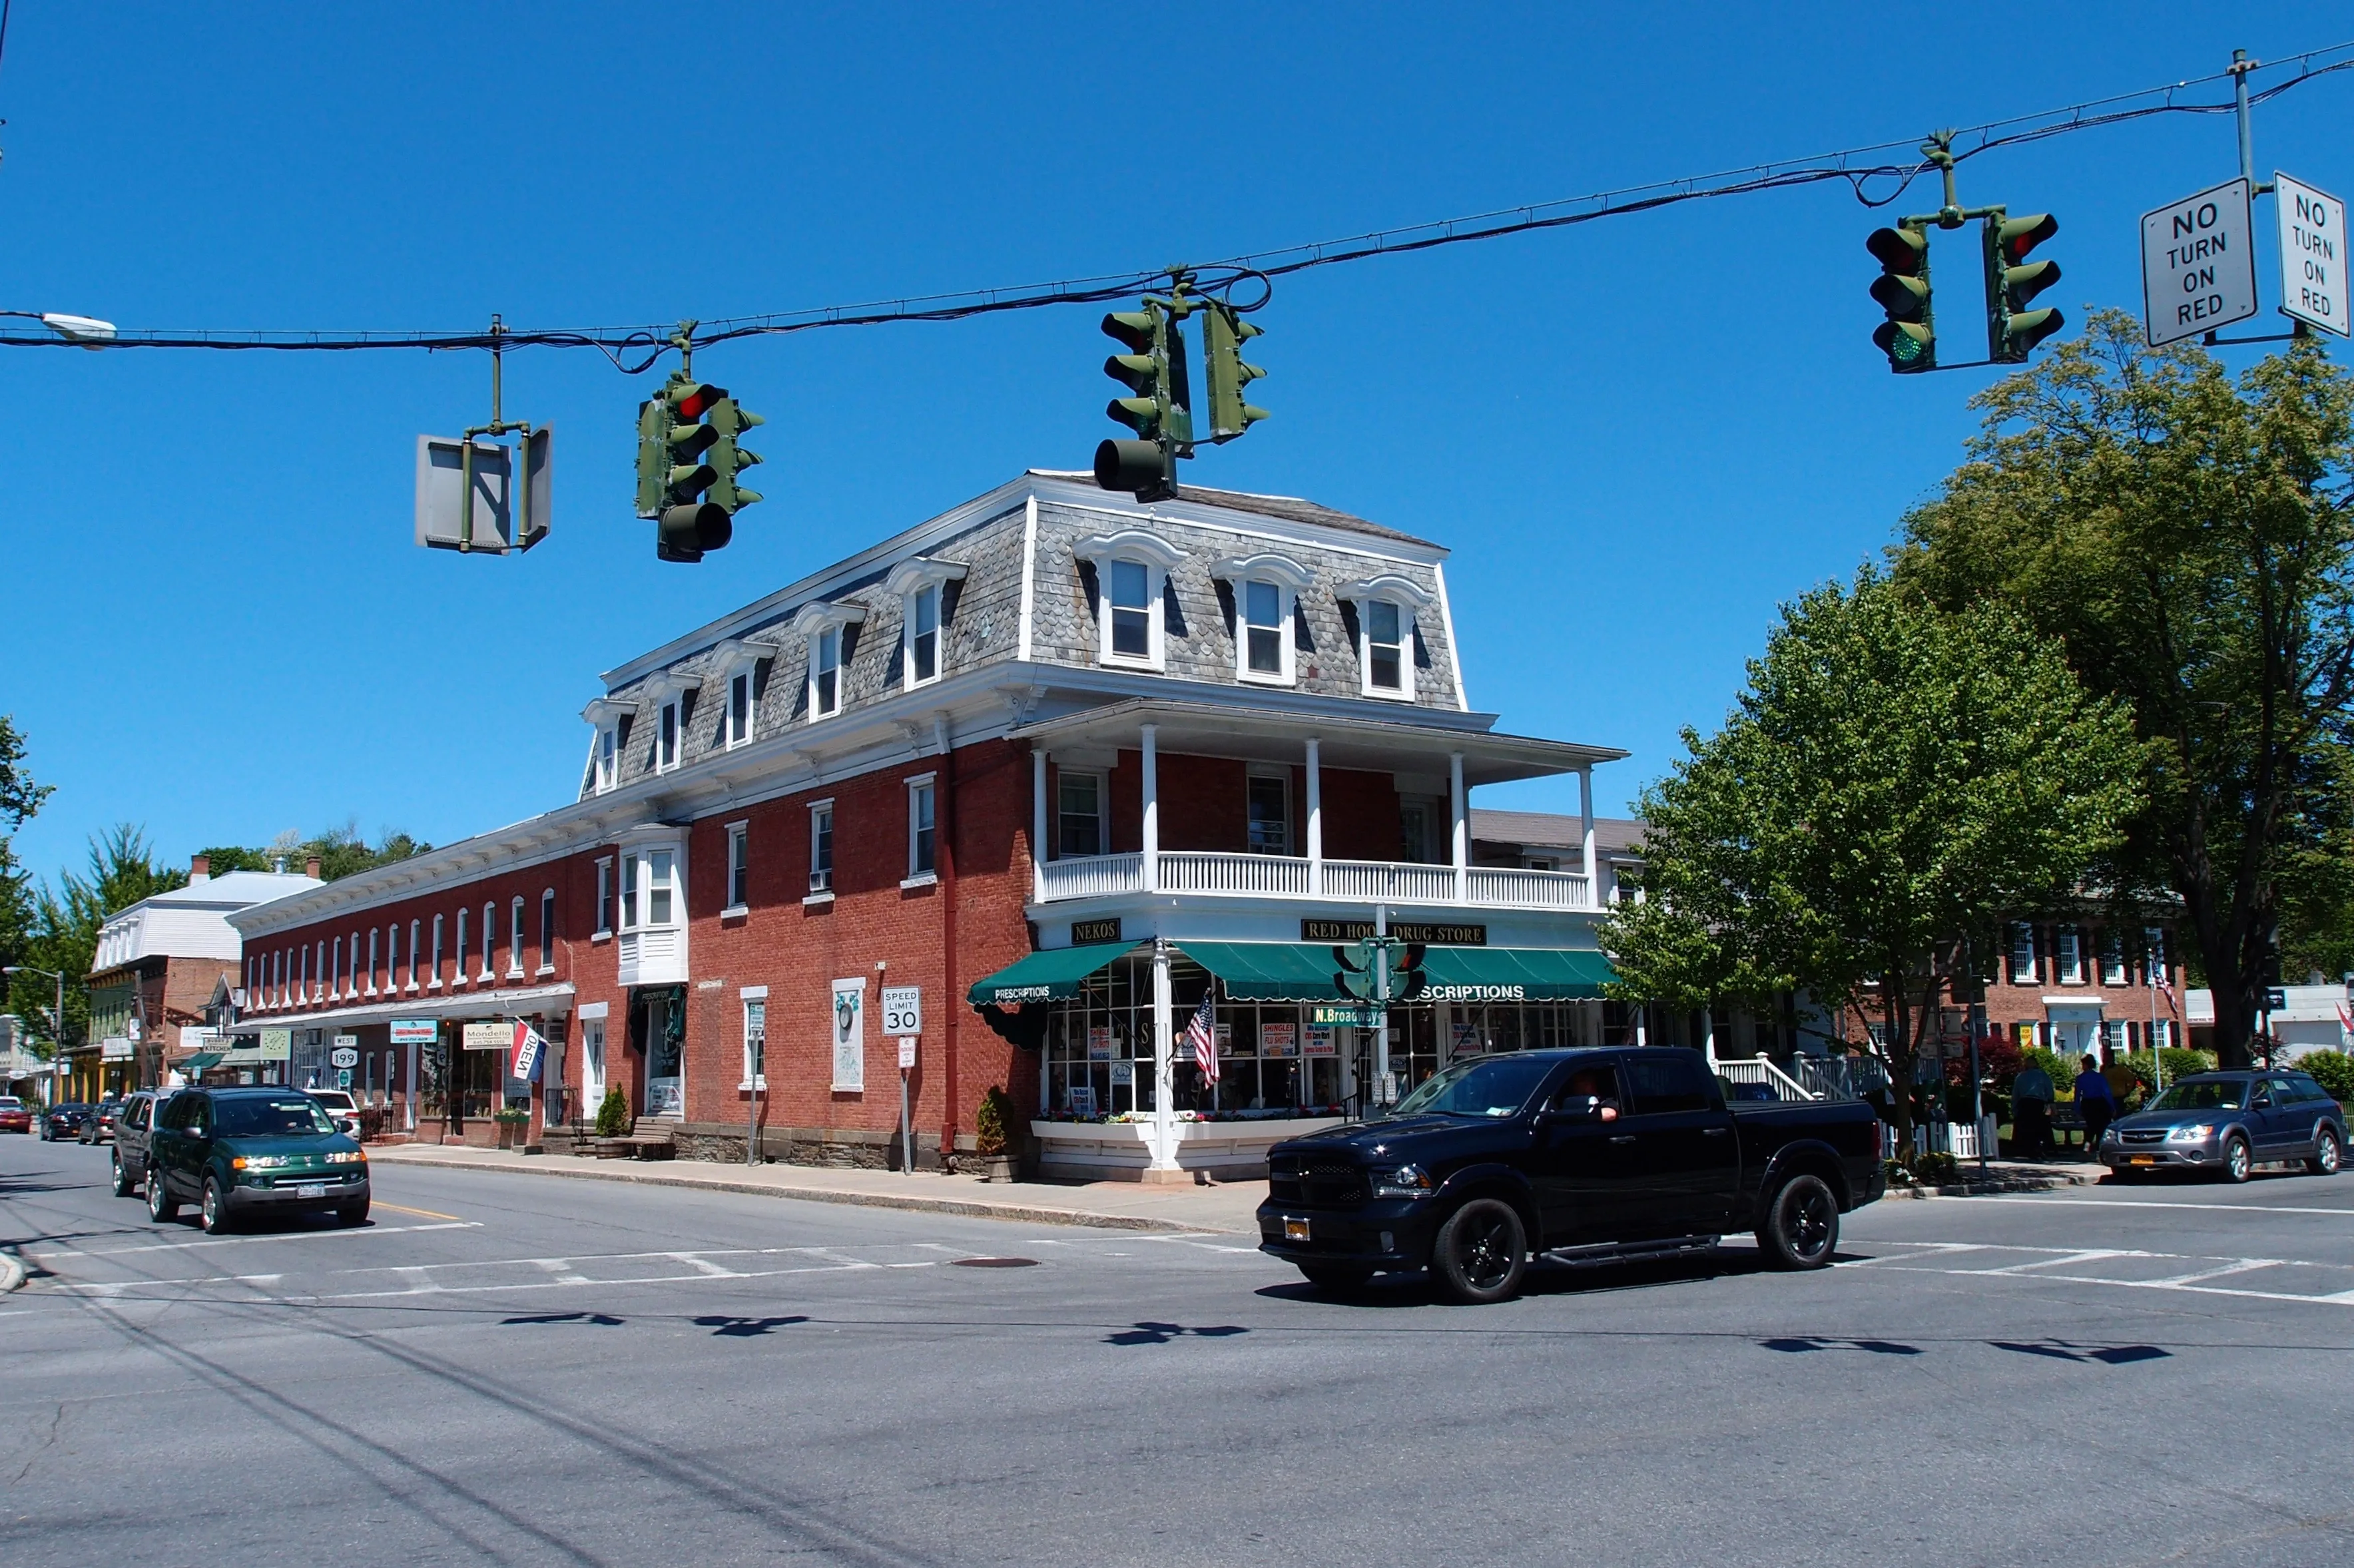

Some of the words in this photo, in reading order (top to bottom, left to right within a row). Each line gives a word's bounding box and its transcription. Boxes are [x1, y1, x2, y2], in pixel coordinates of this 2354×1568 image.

[2173, 202, 2217, 240] NO
[2296, 194, 2325, 227] NO
[2167, 232, 2225, 269] TURN
[2293, 226, 2332, 260] TURN
[2184, 266, 2214, 293] ON
[2304, 260, 2324, 286] ON
[2178, 294, 2223, 325] RED
[2302, 287, 2330, 316] RED
[1075, 922, 1115, 940] NEKOS
[1309, 923, 1340, 937] RED
[1346, 923, 1376, 939] HOO
[1393, 925, 1432, 940] DRUG
[1438, 927, 1482, 942] STORE
[886, 992, 916, 1001] SPEED
[995, 985, 1049, 999] PRESCRIPTIONS
[888, 1011, 916, 1029] 30
[335, 1054, 354, 1064] 199
